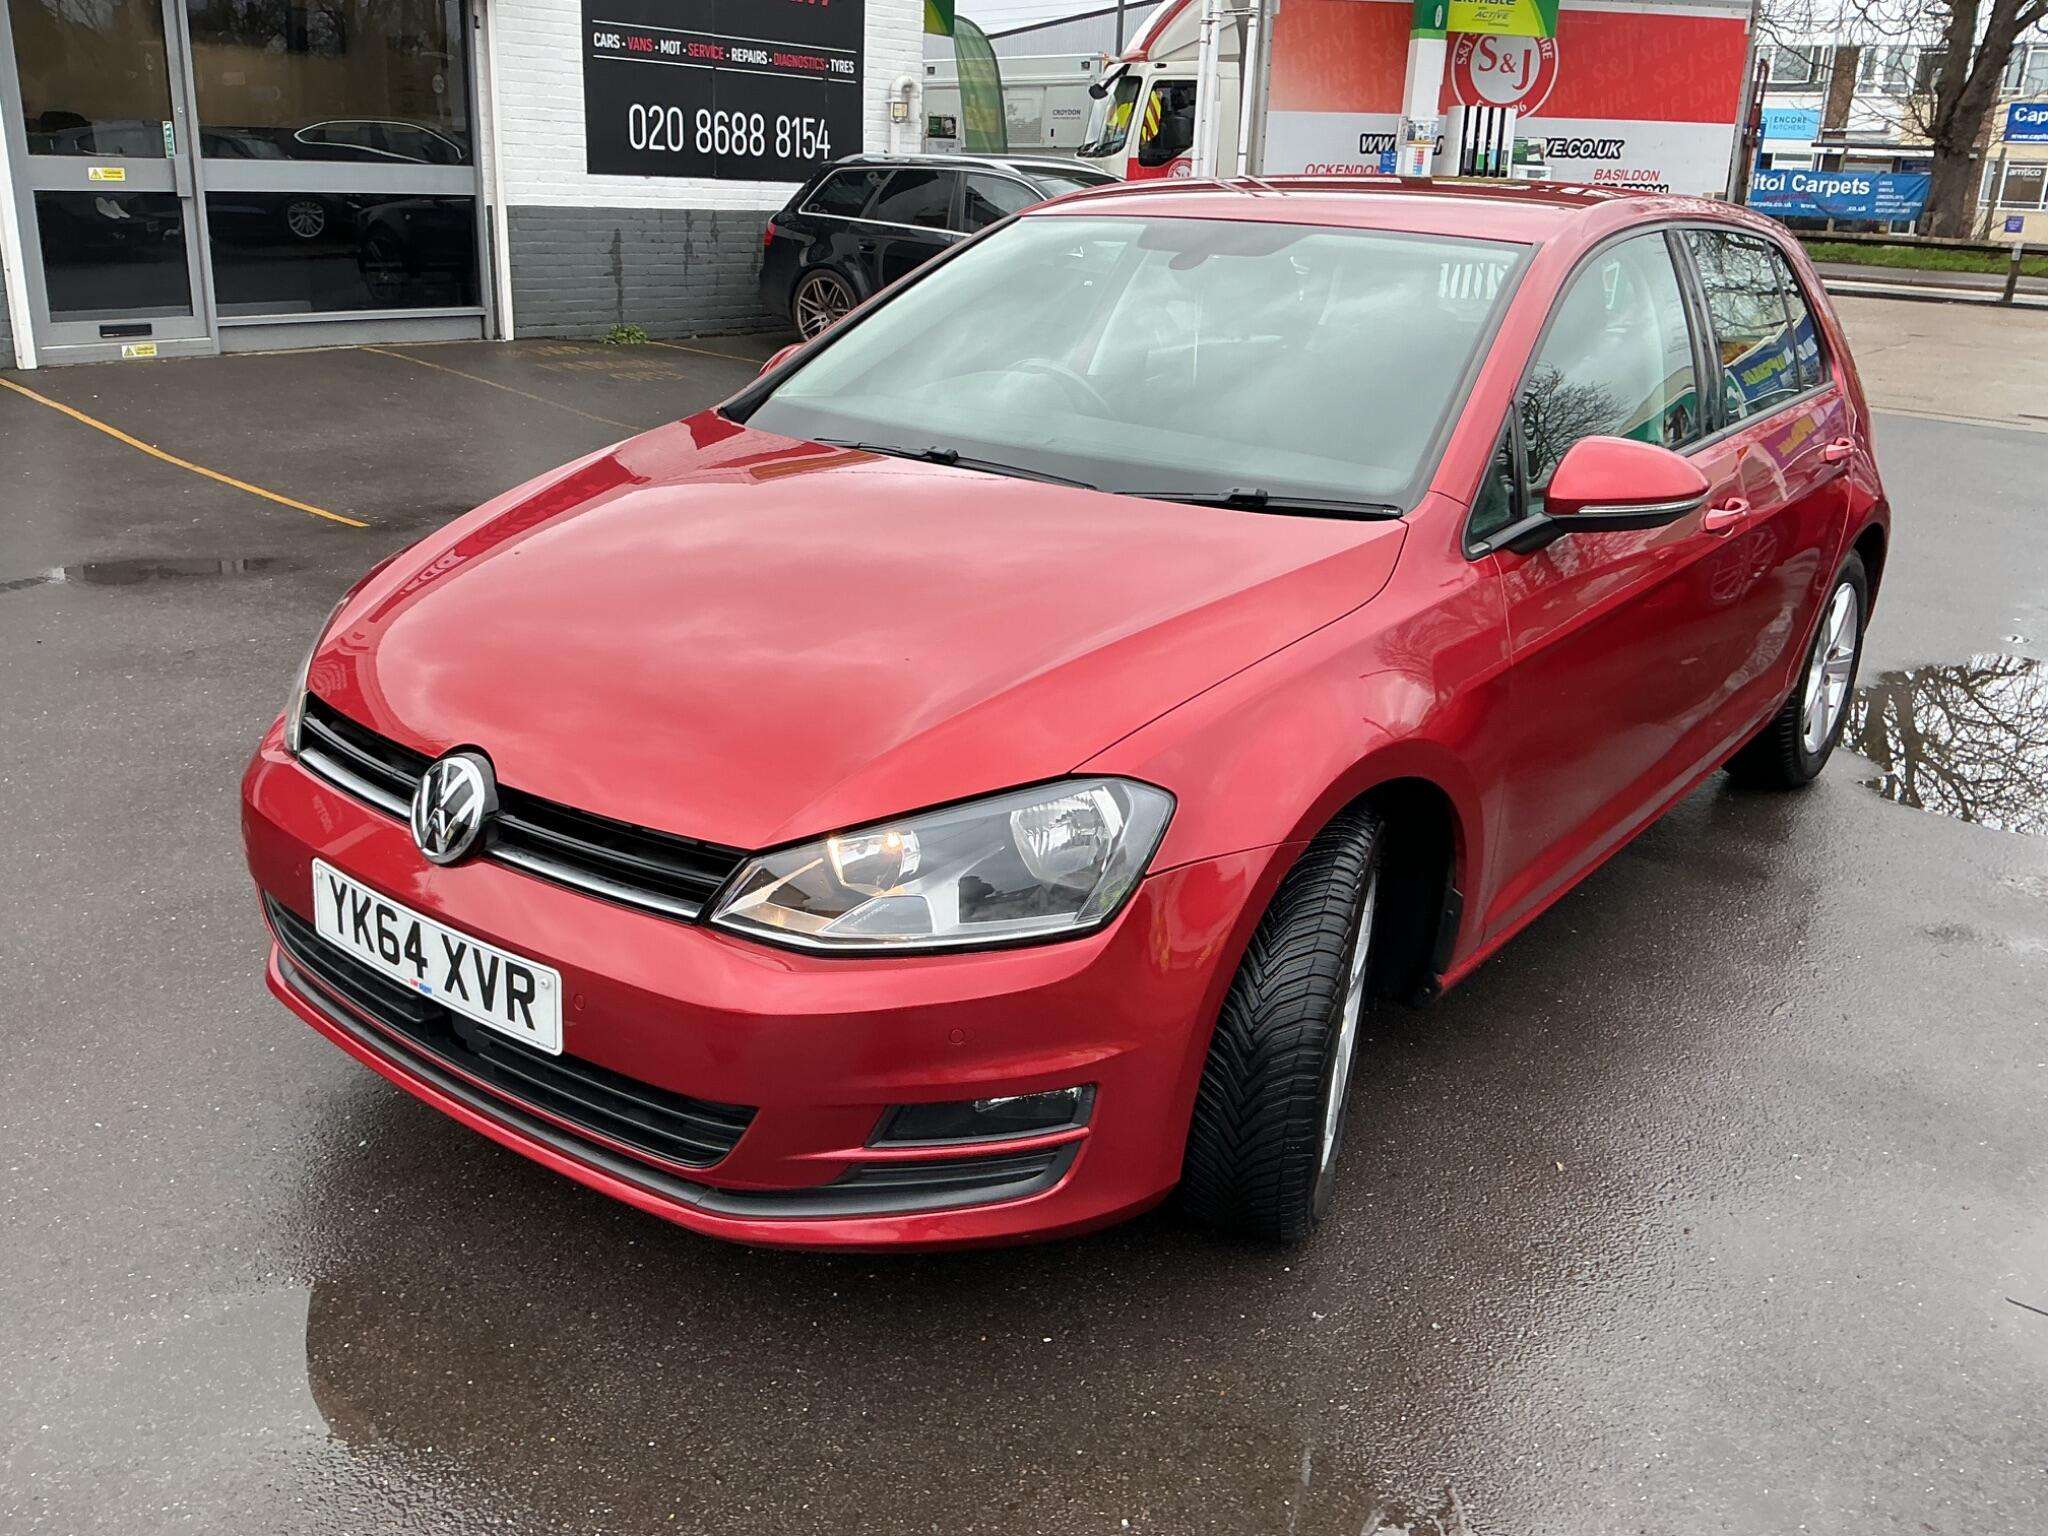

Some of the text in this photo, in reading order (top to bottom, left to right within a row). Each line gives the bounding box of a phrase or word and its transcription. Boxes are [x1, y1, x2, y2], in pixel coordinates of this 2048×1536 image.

[593, 32, 855, 74] CARS VANS MOT SERVICE REPAIRS DIAGNOSTICS TYRES
[1478, 36, 1532, 90] S&J
[628, 103, 831, 160] 020 8688 8154
[1774, 116, 1807, 124] ENCORE
[1594, 169, 1660, 182] BASILDON
[1791, 174, 1870, 198] Carpets
[2008, 168, 2041, 177] amtico
[329, 874, 536, 1031] YK64 XVR
